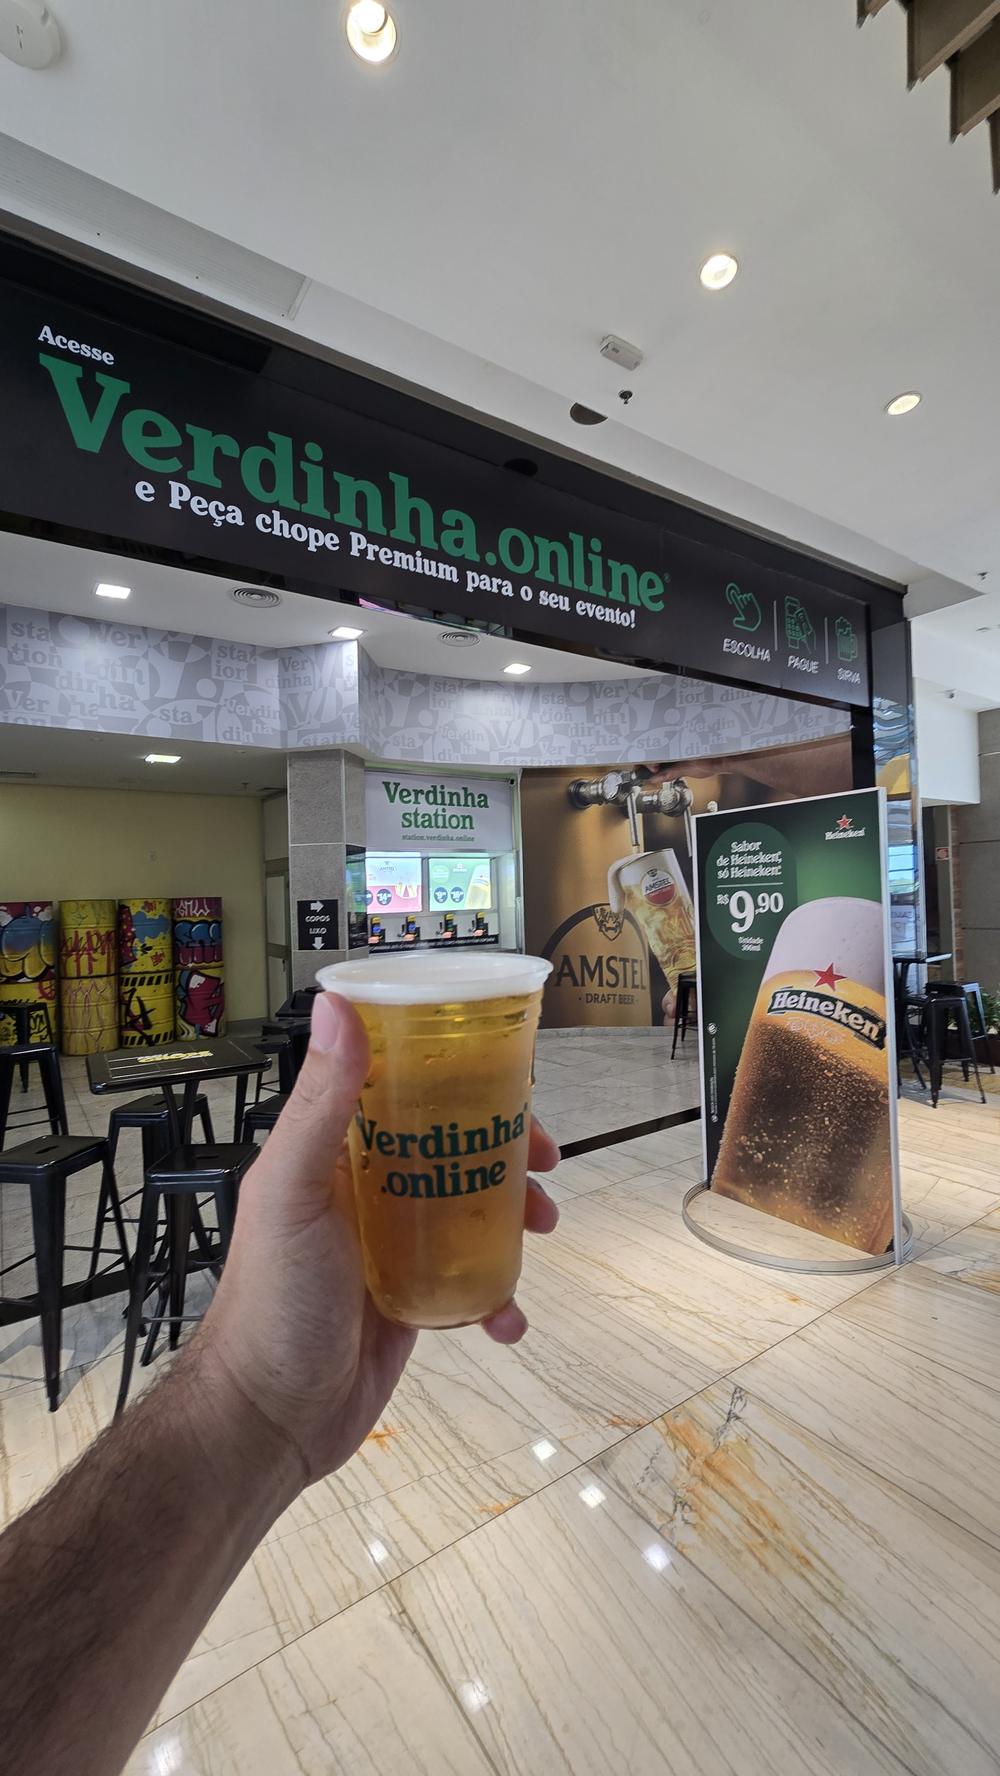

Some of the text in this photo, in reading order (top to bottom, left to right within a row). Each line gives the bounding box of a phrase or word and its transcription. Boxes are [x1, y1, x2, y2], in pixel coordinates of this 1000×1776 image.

[38, 325, 115, 365] Acesse
[135, 480, 637, 629] e Peça chope Premium para o seu evento!
[722, 638, 770, 662] ESCOLHA
[787, 655, 819, 674] PAGUE
[381, 780, 490, 809] Verdinha
[401, 807, 475, 830] station
[731, 840, 762, 853] Sabor
[716, 855, 730, 867] de
[305, 914, 331, 923] COPOS
[309, 927, 327, 935] LIXO
[555, 954, 647, 990] AMSTEL
[584, 992, 617, 1004] DRAFT
[770, 991, 881, 1041] Heineken
[356, 1098, 525, 1159] Verdinha
[381, 1160, 506, 1199] .online
